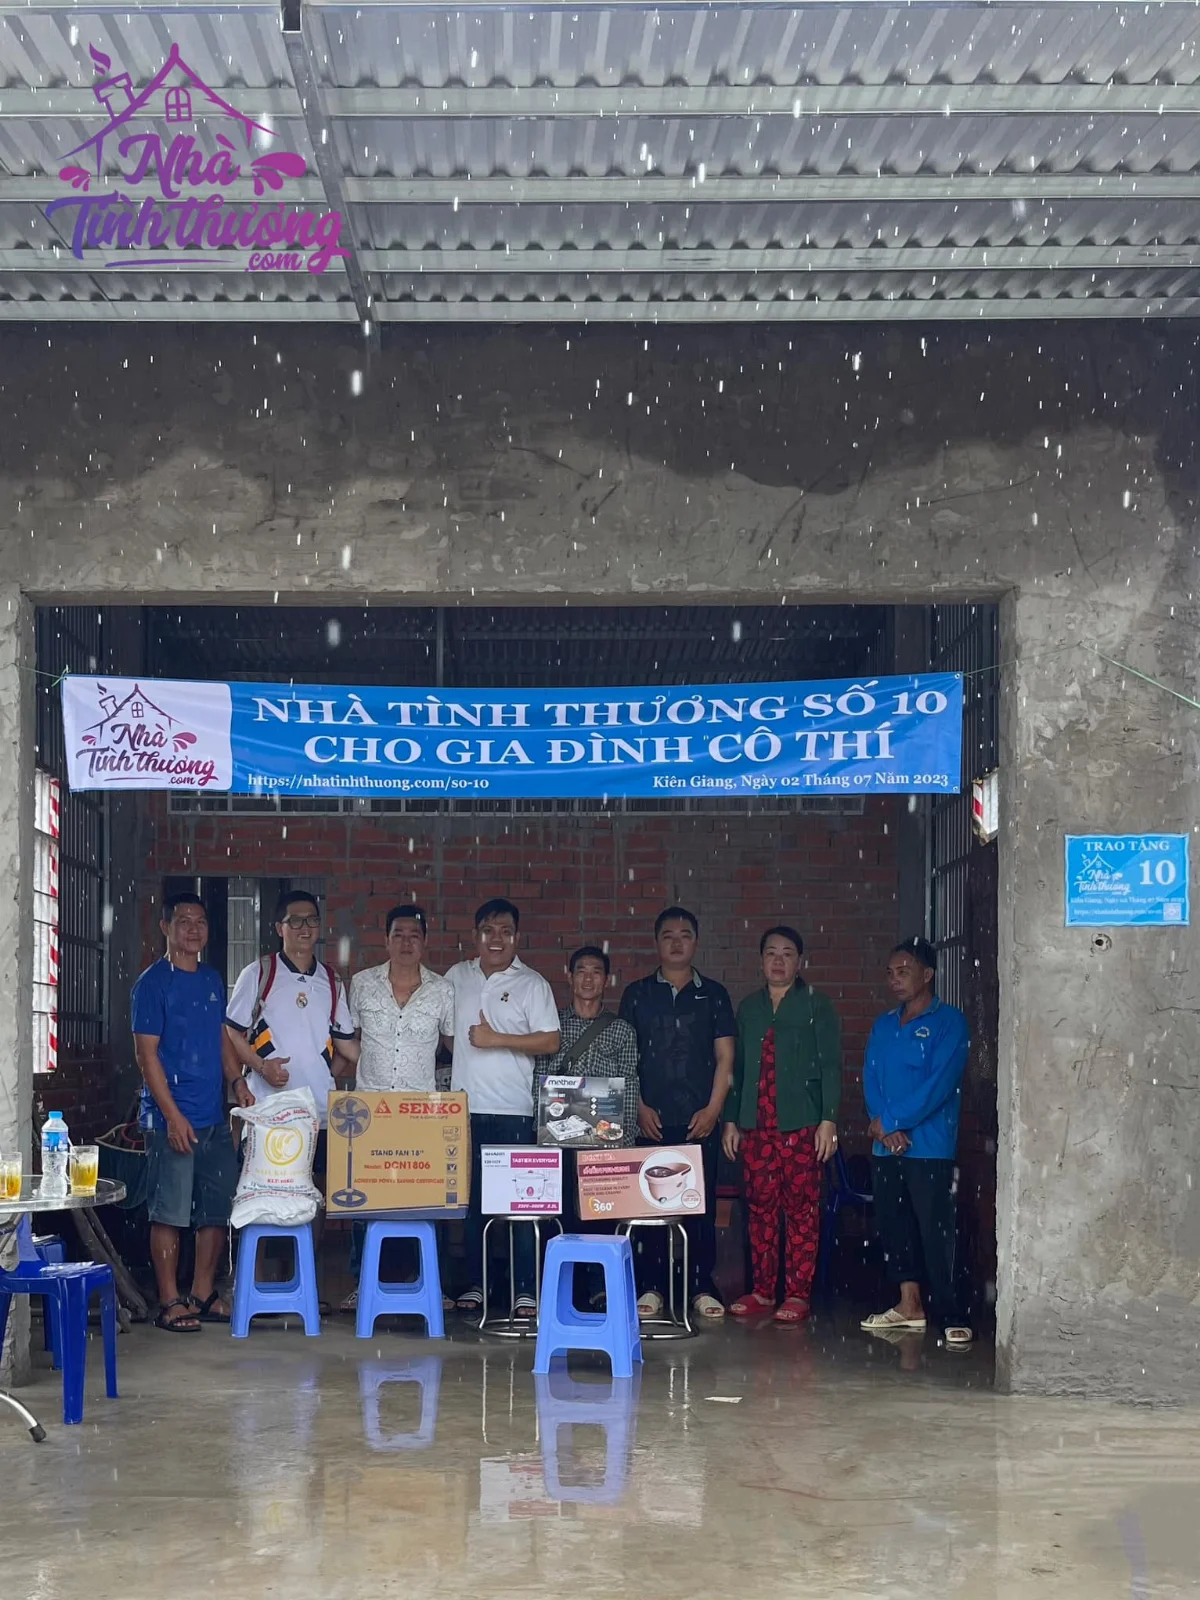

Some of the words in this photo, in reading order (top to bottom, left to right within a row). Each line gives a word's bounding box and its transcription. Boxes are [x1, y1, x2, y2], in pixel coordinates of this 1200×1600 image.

[252, 693, 378, 725] NHÀ
[387, 695, 531, 727] TÌNH
[544, 694, 789, 727] THƯƠNG
[802, 680, 879, 718] SỐ
[891, 690, 948, 716] 10
[110, 722, 168, 750] Nhà
[303, 735, 422, 764] CHO
[435, 738, 535, 765] GIA
[546, 731, 694, 765] ĐÌNH
[708, 726, 781, 764] CÔ
[795, 721, 896, 762] THÍ
[247, 773, 490, 790] https://nhatinhthuong.com/so-10
[653, 775, 687, 788] Kiên
[690, 775, 738, 790] Giang,
[741, 775, 779, 790] Ngày
[781, 777, 800, 786] 02
[802, 774, 850, 788] Tháng
[853, 776, 872, 788] 07
[875, 773, 910, 786] Năm
[913, 775, 949, 787] 2023
[1083, 841, 1125, 852] TRAO
[1139, 860, 1176, 885] 10
[399, 1102, 462, 1115] SENKO
